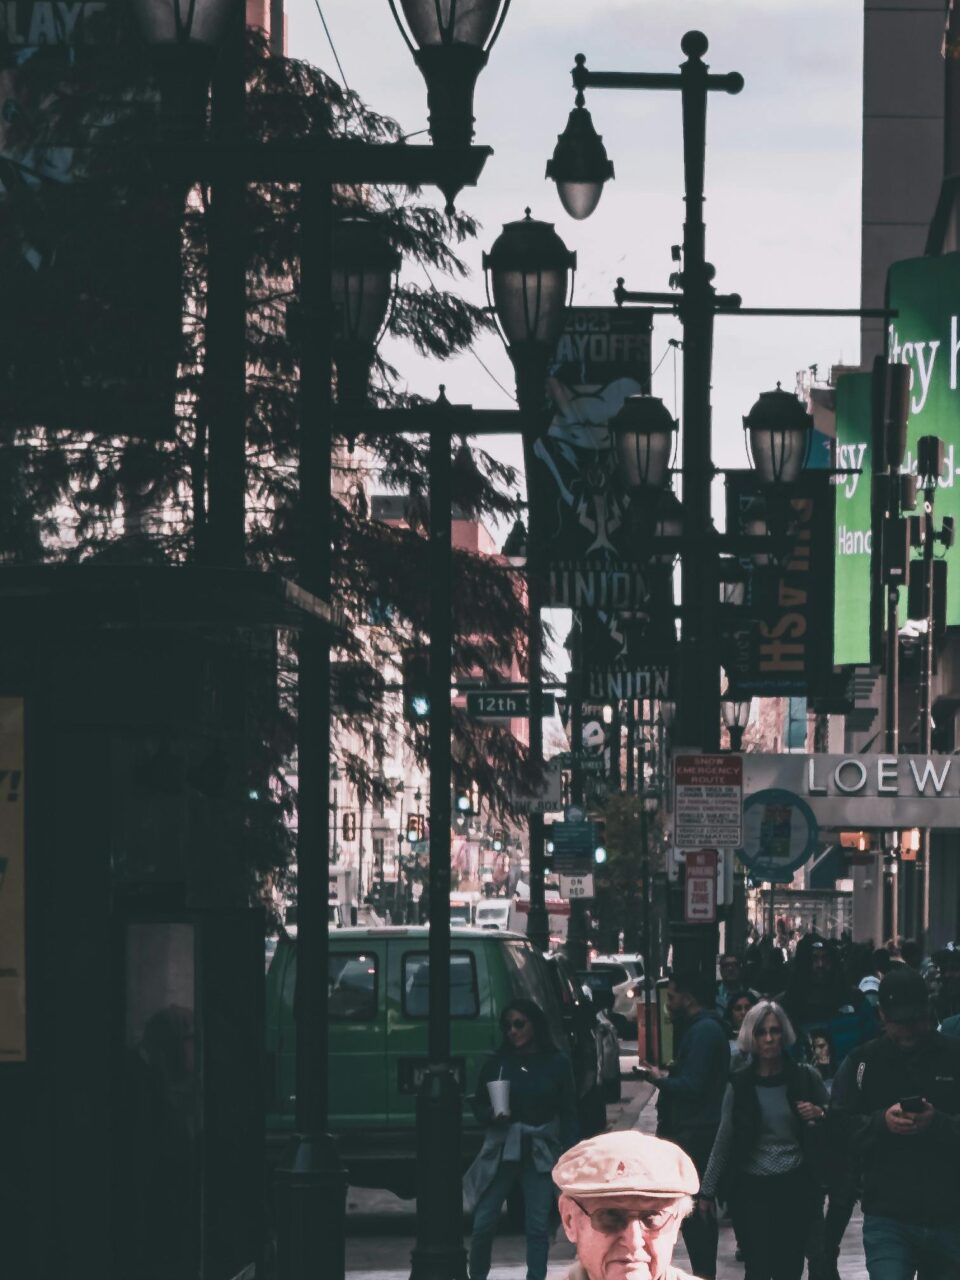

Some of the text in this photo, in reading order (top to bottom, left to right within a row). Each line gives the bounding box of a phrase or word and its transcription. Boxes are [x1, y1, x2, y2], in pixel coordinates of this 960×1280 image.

[556, 333, 650, 363] AYOFFS
[887, 323, 941, 415] tsy
[836, 437, 868, 499] tsy
[590, 671, 669, 699] UNION
[478, 697, 516, 711] 12th
[694, 758, 725, 766] SNOW
[677, 767, 740, 775] EMERGENCY
[691, 776, 725, 784] ROUTE
[570, 878, 582, 886] ON
[693, 881, 708, 891] BUS
[569, 887, 585, 895] RED
[691, 893, 709, 904] ZONE
